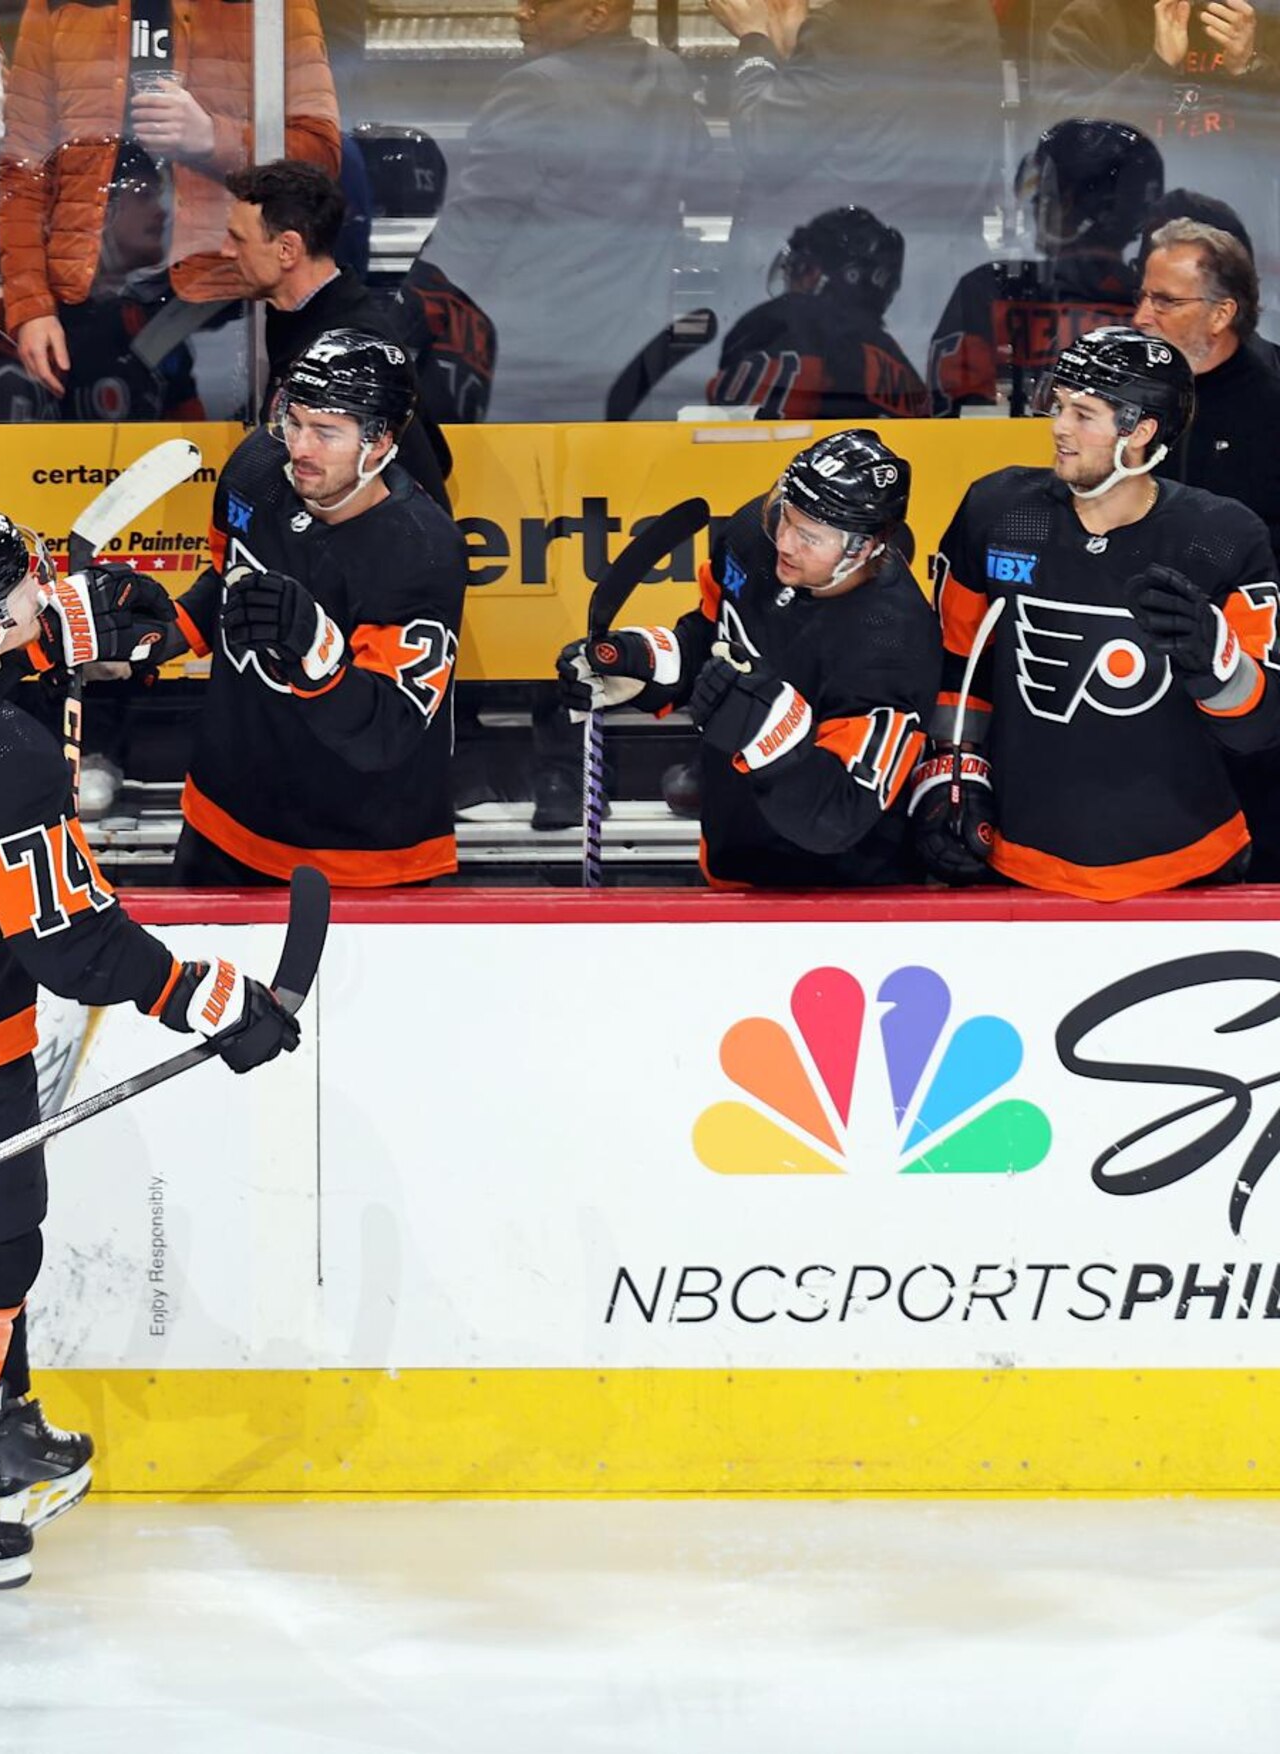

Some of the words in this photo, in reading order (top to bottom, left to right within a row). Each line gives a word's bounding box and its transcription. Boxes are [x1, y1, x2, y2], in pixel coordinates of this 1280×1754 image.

[294, 371, 329, 388] CCM
[987, 555, 1037, 585] IBX
[148, 1171, 169, 1283] Responsibly.
[149, 1288, 170, 1337] Enjoy
